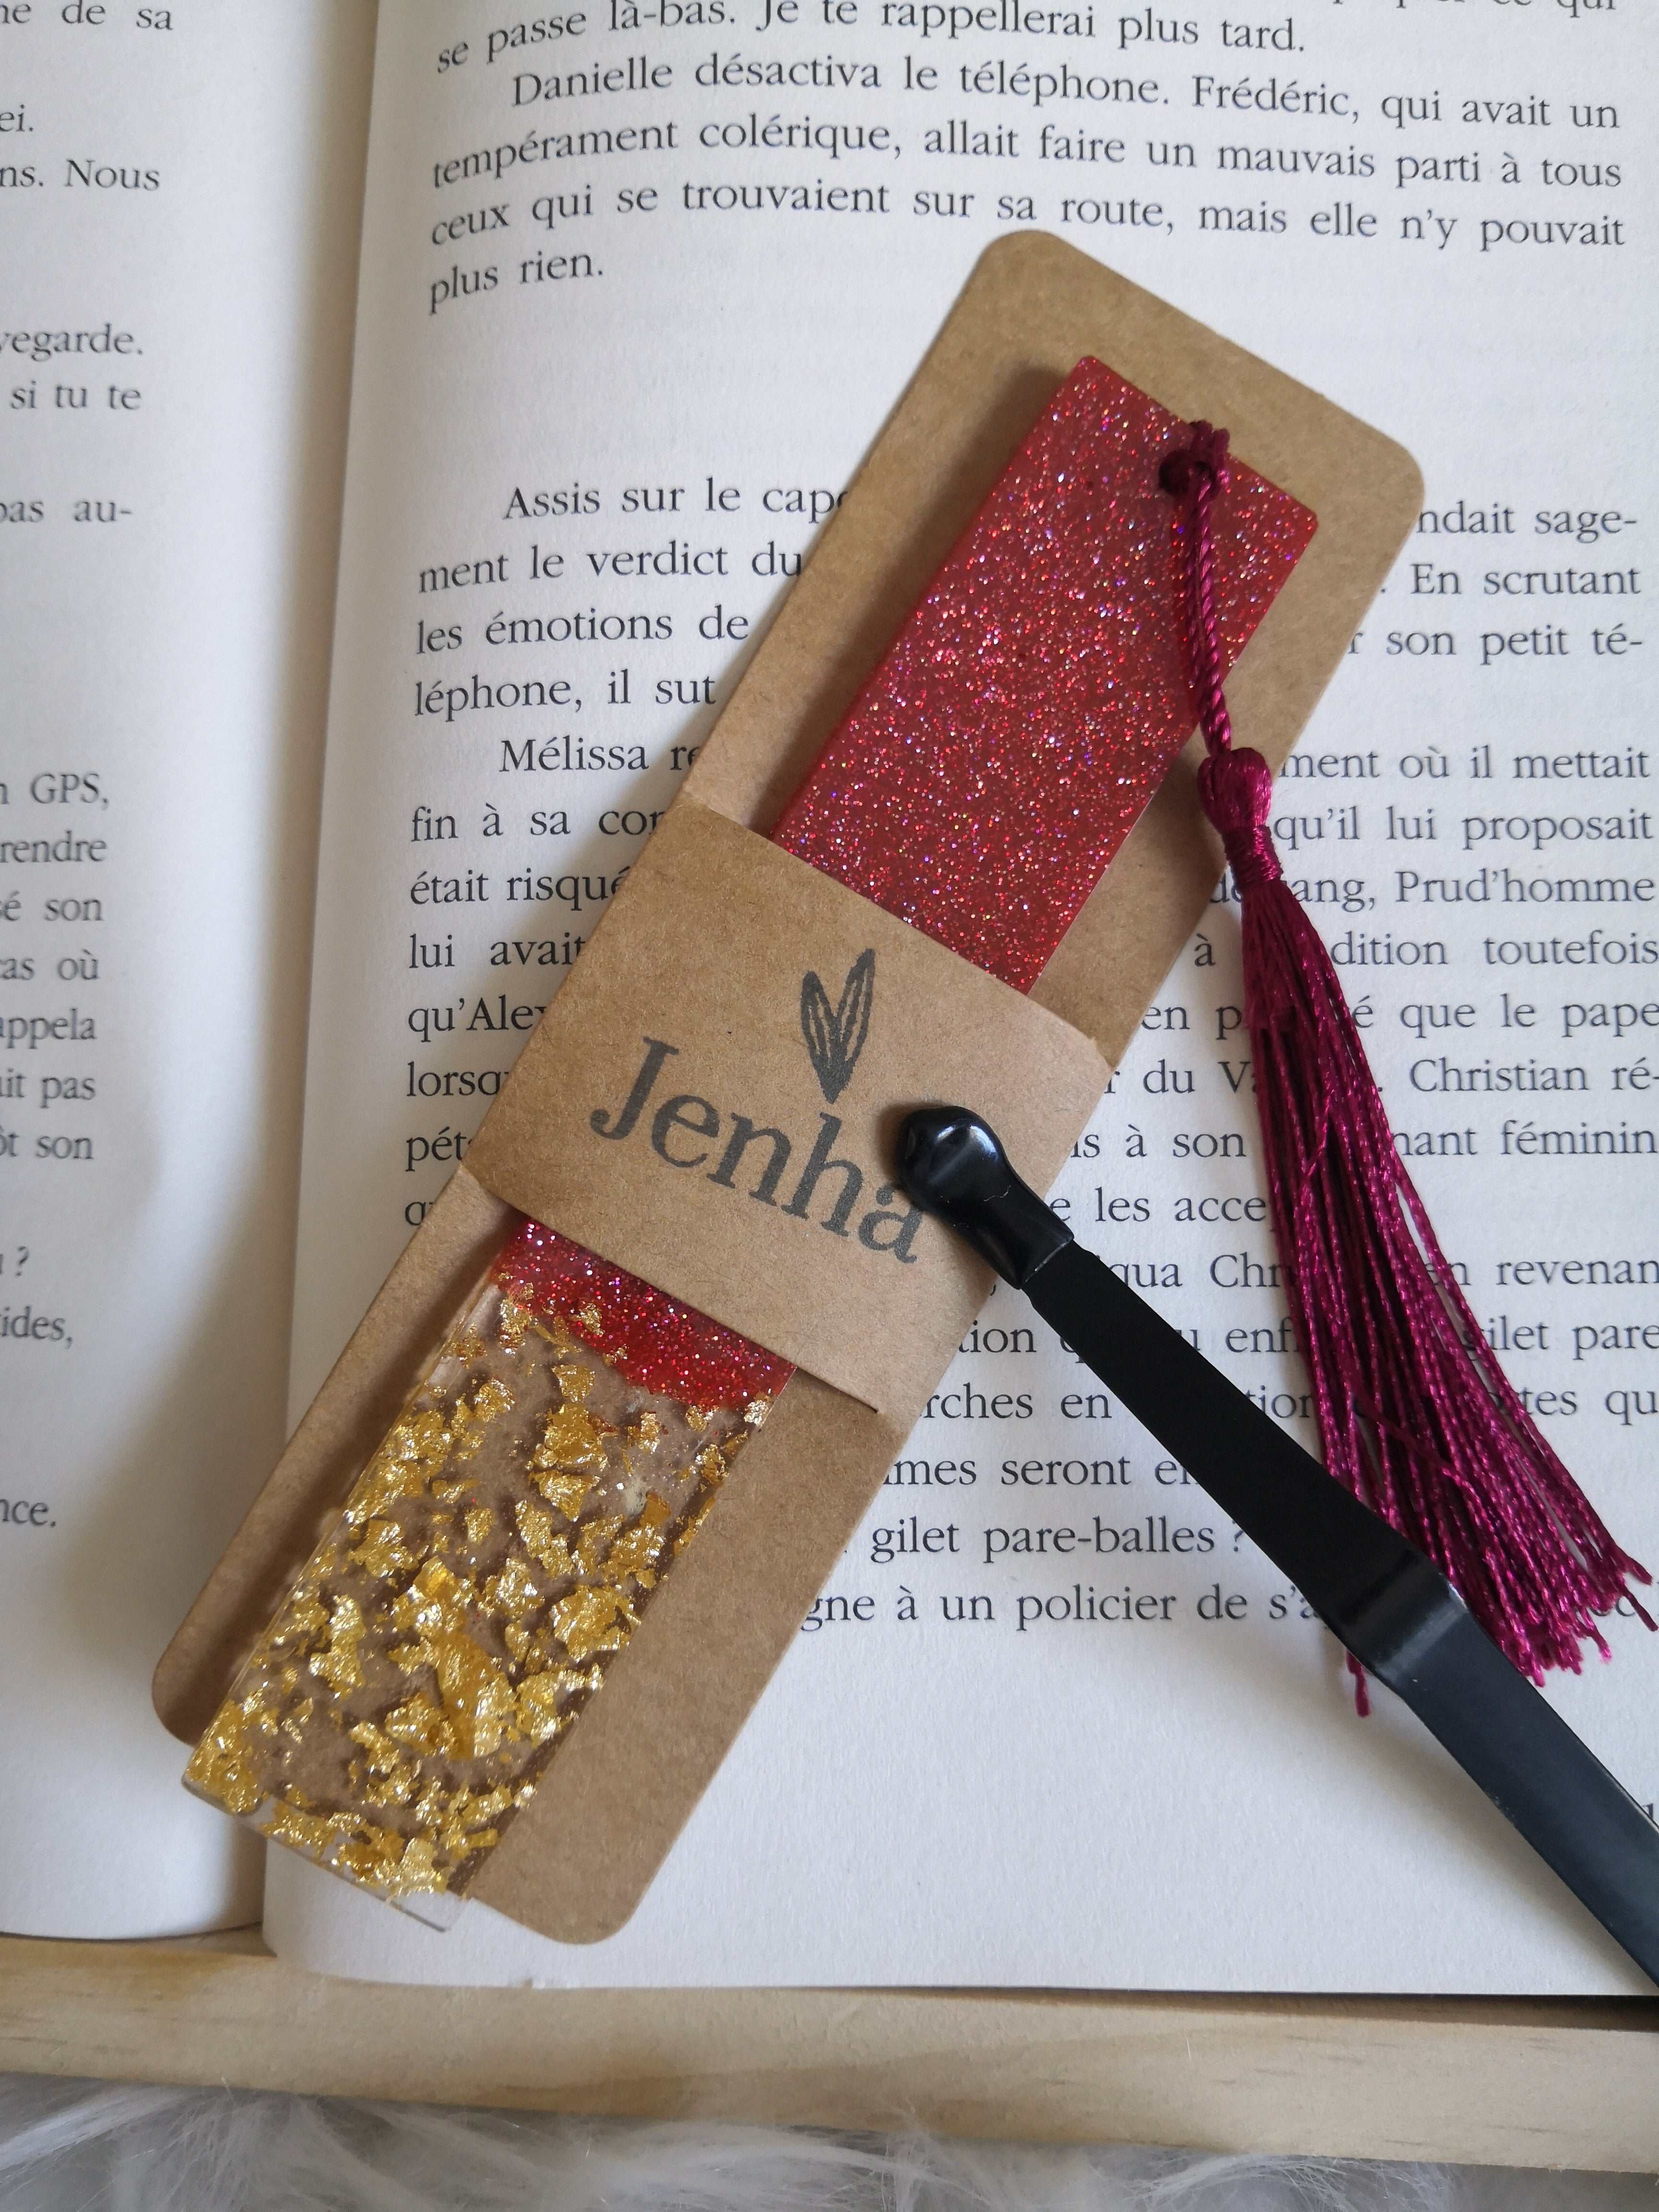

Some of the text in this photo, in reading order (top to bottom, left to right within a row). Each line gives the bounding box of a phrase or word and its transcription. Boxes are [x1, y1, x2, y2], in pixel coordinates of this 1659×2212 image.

[61, 0, 106, 25] de
[136, 8, 174, 31] sa
[437, 0, 1304, 74] se passe là-bas. Je te rappellerai plus tard.
[512, 51, 1620, 130] Danielle désactiva le téléphone. Frédéric, qui avait un
[433, 112, 1622, 191] tempérament colérique, allait faire un mauvais parti à tous
[64, 158, 160, 191] Nous
[431, 204, 510, 245] ceux
[532, 183, 593, 230] qui
[616, 188, 658, 213] se
[682, 178, 890, 214] trouvaient
[913, 191, 975, 218] sur
[997, 195, 1037, 221] sa
[1061, 198, 1174, 236] route,
[1199, 200, 1287, 234] mais
[1309, 201, 1378, 238] elle
[1479, 215, 1625, 252] pouvait
[429, 250, 603, 316] plus rien.
[10, 380, 142, 410] si tu te
[73, 500, 132, 523] au-
[502, 475, 849, 524] Assis sur le cap
[1534, 510, 1637, 544] sage-
[419, 538, 802, 593] ment le verdict du
[1410, 563, 1641, 595] En scrutant
[416, 603, 748, 655] les émotions de
[1386, 631, 1457, 656] son
[1479, 624, 1570, 666] petit
[1591, 622, 1644, 656] té-
[414, 668, 717, 723] léphone, il sut
[499, 734, 649, 772] Mélissa
[1399, 745, 1450, 779] où
[1469, 744, 1494, 779] il
[1512, 746, 1651, 779] mettait
[30, 772, 109, 810] GPS,
[410, 805, 459, 842] fin
[482, 802, 504, 837] à
[530, 811, 571, 836] sa
[1385, 805, 1438, 841] lui
[1461, 807, 1654, 851] proposait
[410, 869, 490, 905] était
[1282, 876, 1375, 912] ang,
[44, 898, 104, 922] son
[56, 949, 99, 981] où
[409, 933, 456, 969] lui
[1194, 929, 1659, 967] à dition toutefois
[1399, 1004, 1476, 1039] que
[1500, 992, 1537, 1028] le
[1560, 1002, 1659, 1038] pape
[40, 1077, 96, 1109] pas
[406, 1060, 508, 1097] lorsq
[1142, 1058, 1196, 1094] du
[1408, 1056, 1591, 1092] Christian
[35, 1135, 94, 1160] son
[406, 1127, 471, 1173] pét
[589, 1035, 924, 1264] Jenha
[1125, 1124, 1148, 1158] à
[1172, 1133, 1247, 1158] son
[1500, 1119, 1659, 1155] féminin
[1094, 1186, 1150, 1223] les
[1462, 1315, 1548, 1360] ilet
[1060, 1394, 1113, 1420] en
[1001, 1455, 1132, 1486] seront
[870, 1515, 961, 1564] gilet
[983, 1515, 1215, 1564] pare-balles
[897, 1585, 919, 1621] à
[939, 1595, 996, 1622] un
[1016, 1583, 1177, 1632] policier
[1196, 1582, 1248, 1621] de
